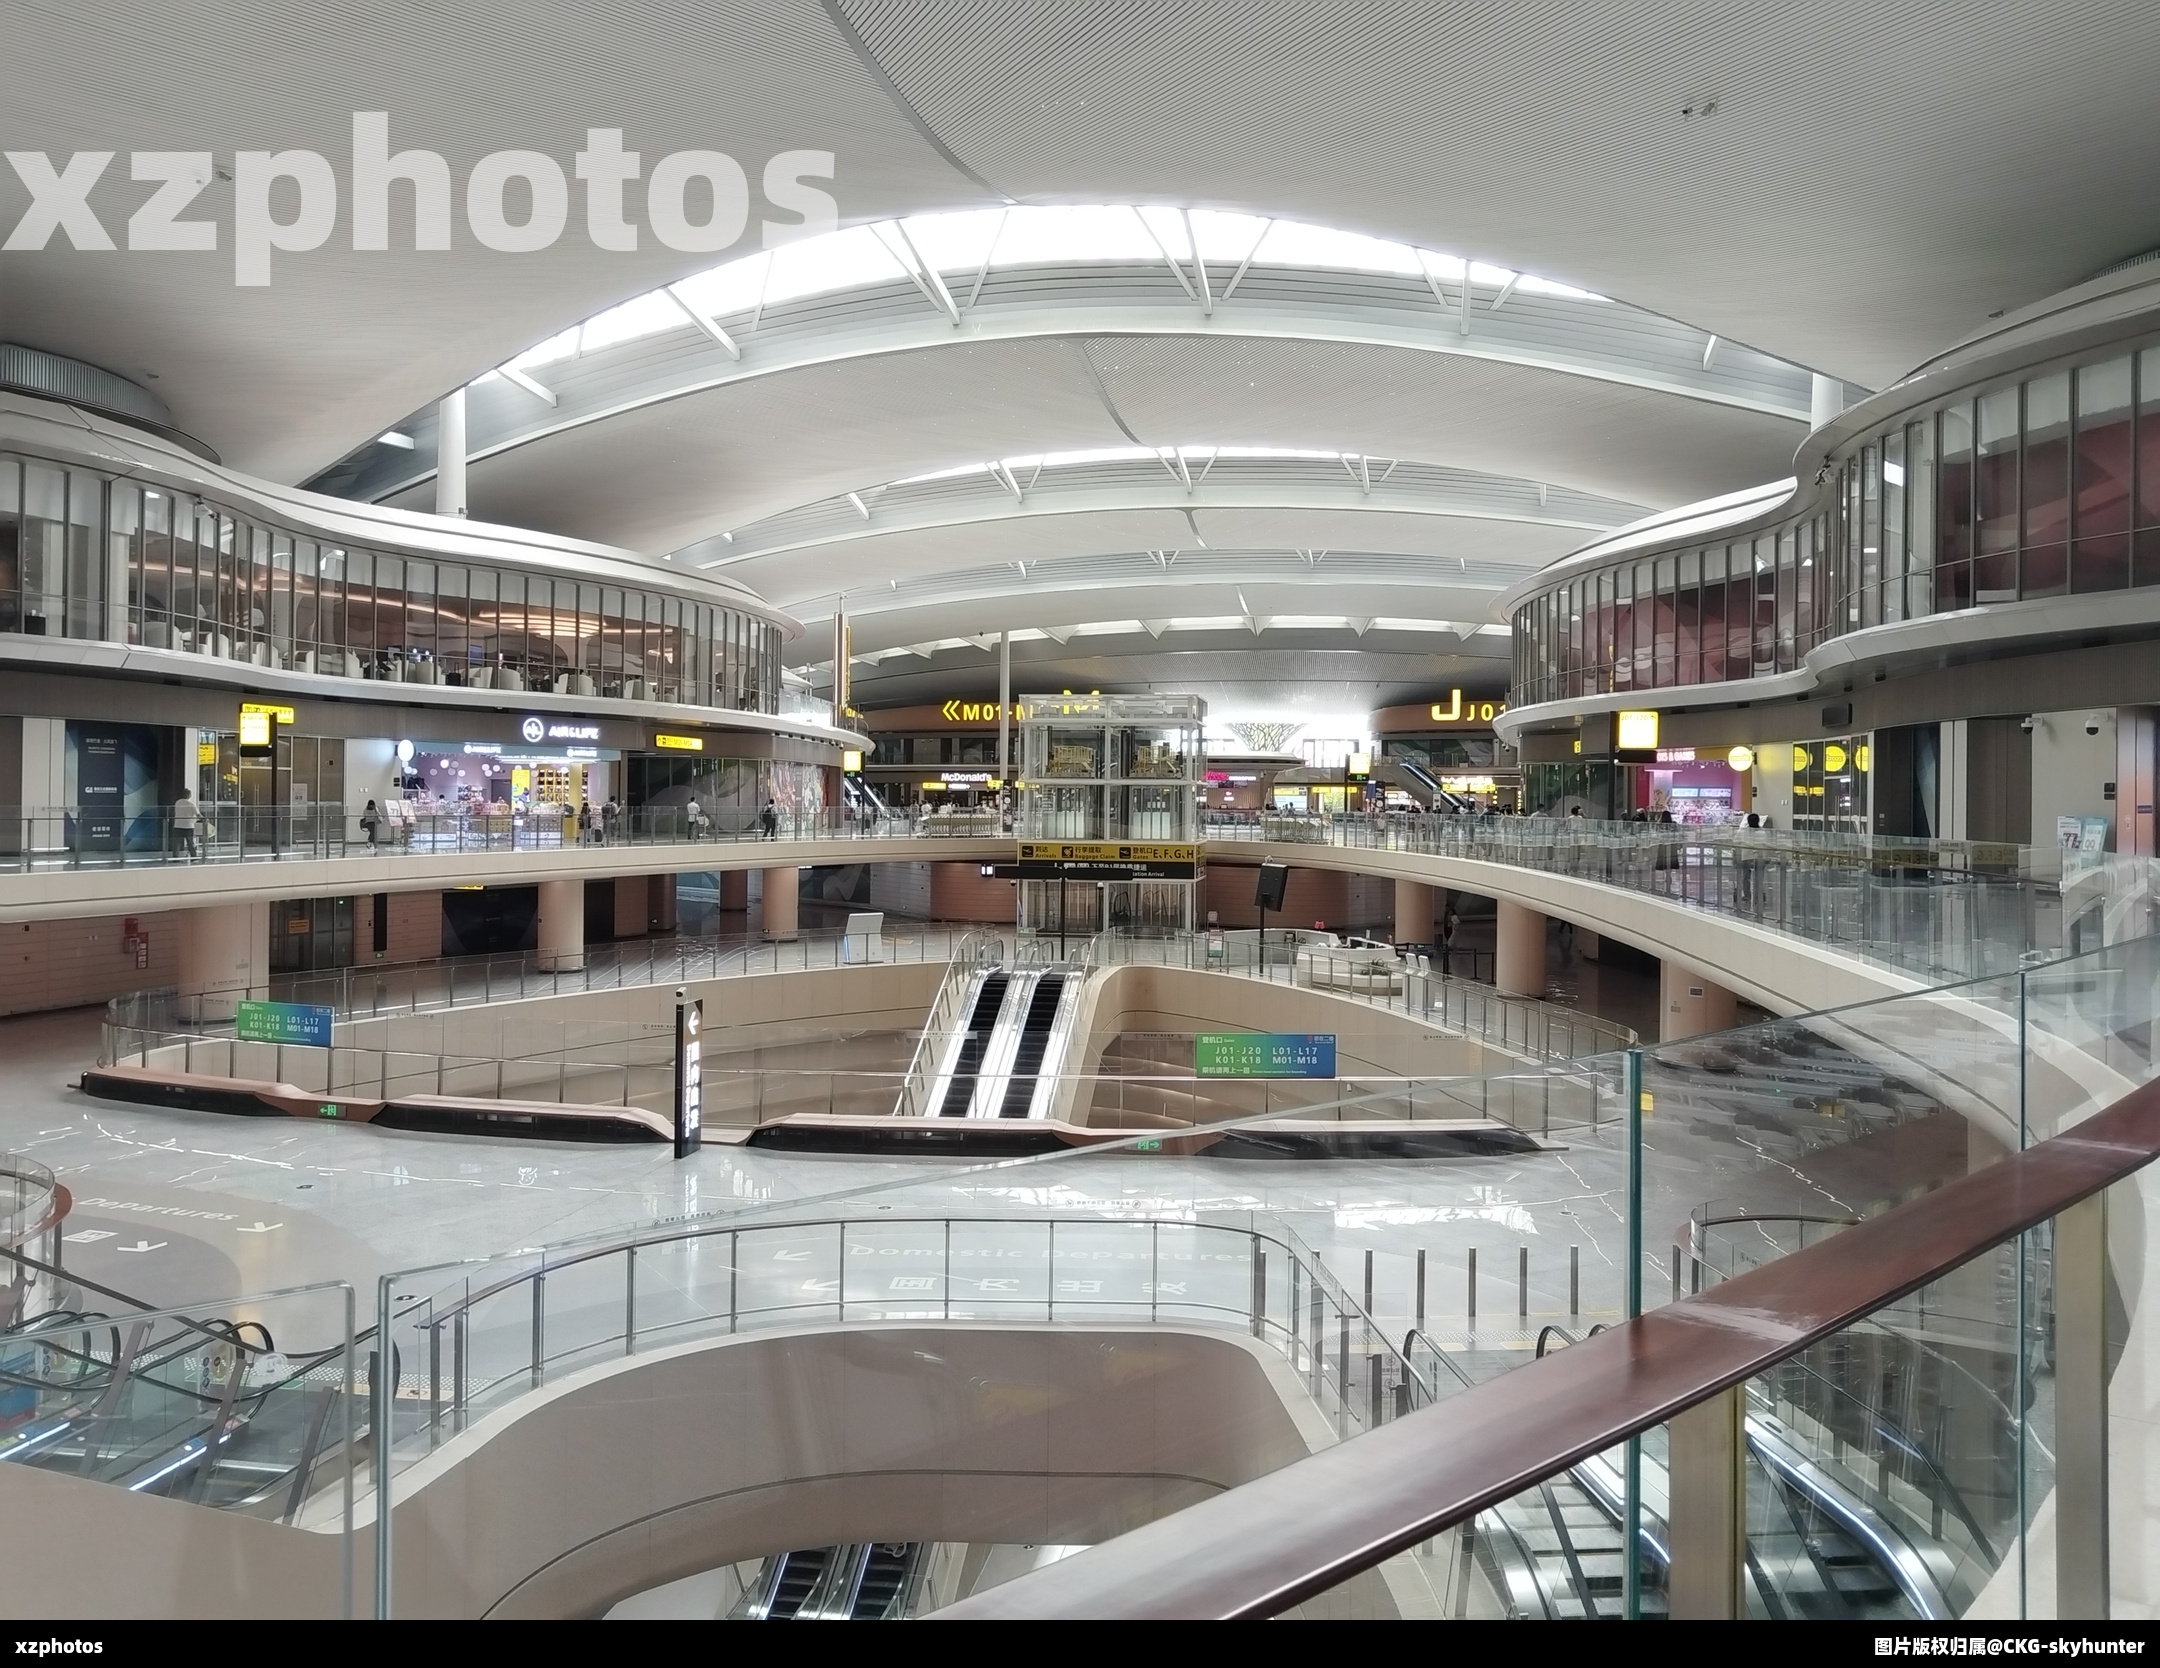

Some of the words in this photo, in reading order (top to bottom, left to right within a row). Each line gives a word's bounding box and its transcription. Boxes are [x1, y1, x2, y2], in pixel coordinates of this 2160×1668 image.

[1431, 689, 1462, 721] J
[548, 726, 599, 739] AIR&LIFE
[941, 773, 993, 782] McDonald's
[1132, 846, 1153, 854] 登机口
[249, 1013, 280, 1022] J01-J20
[286, 1015, 319, 1025] L01-L17
[249, 1021, 280, 1031] K01-K18
[286, 1024, 319, 1034] M01-M18
[1202, 1036, 1223, 1044] 登机口
[1215, 1046, 1261, 1055] J01-J20
[1272, 1046, 1318, 1055] L01-L17
[1215, 1056, 1261, 1064] K01-K18
[1272, 1056, 1318, 1064] M01-M18
[77, 1197, 239, 1221] Departures
[849, 1246, 1024, 1258] Domestic
[1041, 1249, 1252, 1263] Departures
